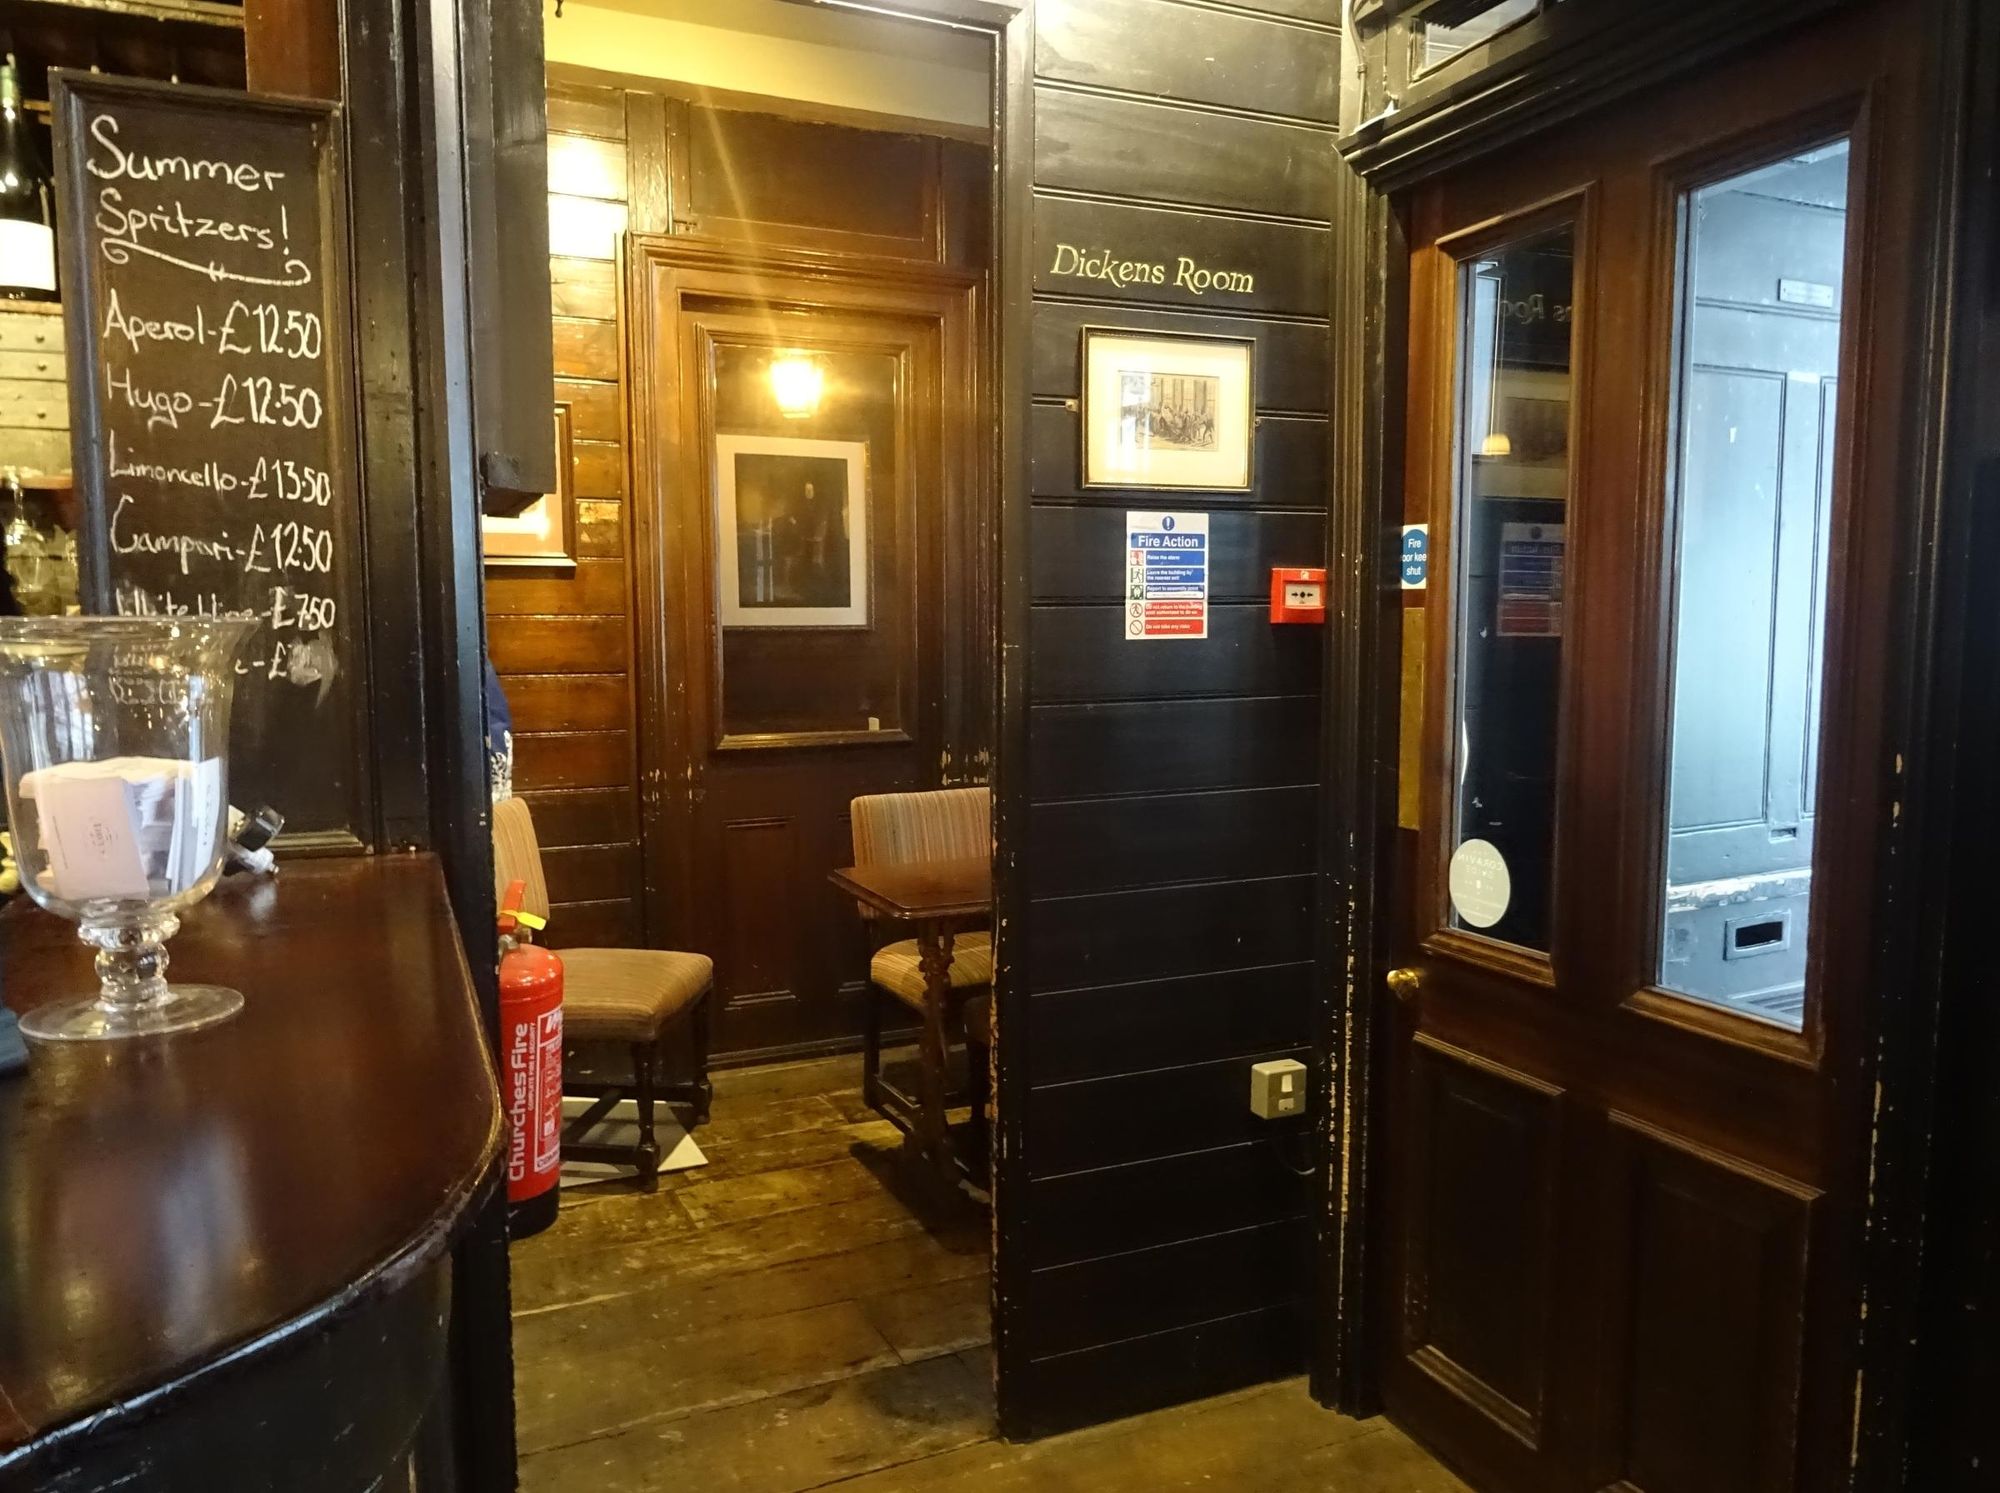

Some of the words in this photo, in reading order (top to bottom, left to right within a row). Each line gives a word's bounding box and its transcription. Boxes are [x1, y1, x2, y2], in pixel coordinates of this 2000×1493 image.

[87, 115, 285, 191] Summer
[96, 188, 290, 256] Spritzers!
[1050, 244, 1166, 288] Dickens
[1173, 257, 1254, 295] Room
[1138, 535, 1161, 548] Fire
[1162, 536, 1199, 548] Action
[1402, 554, 1414, 563] oor
[1414, 552, 1427, 562] kee
[1408, 538, 1422, 549] Fire
[1406, 565, 1422, 576] shut
[511, 1023, 529, 1069] Fire
[508, 1072, 527, 1182] Churches
